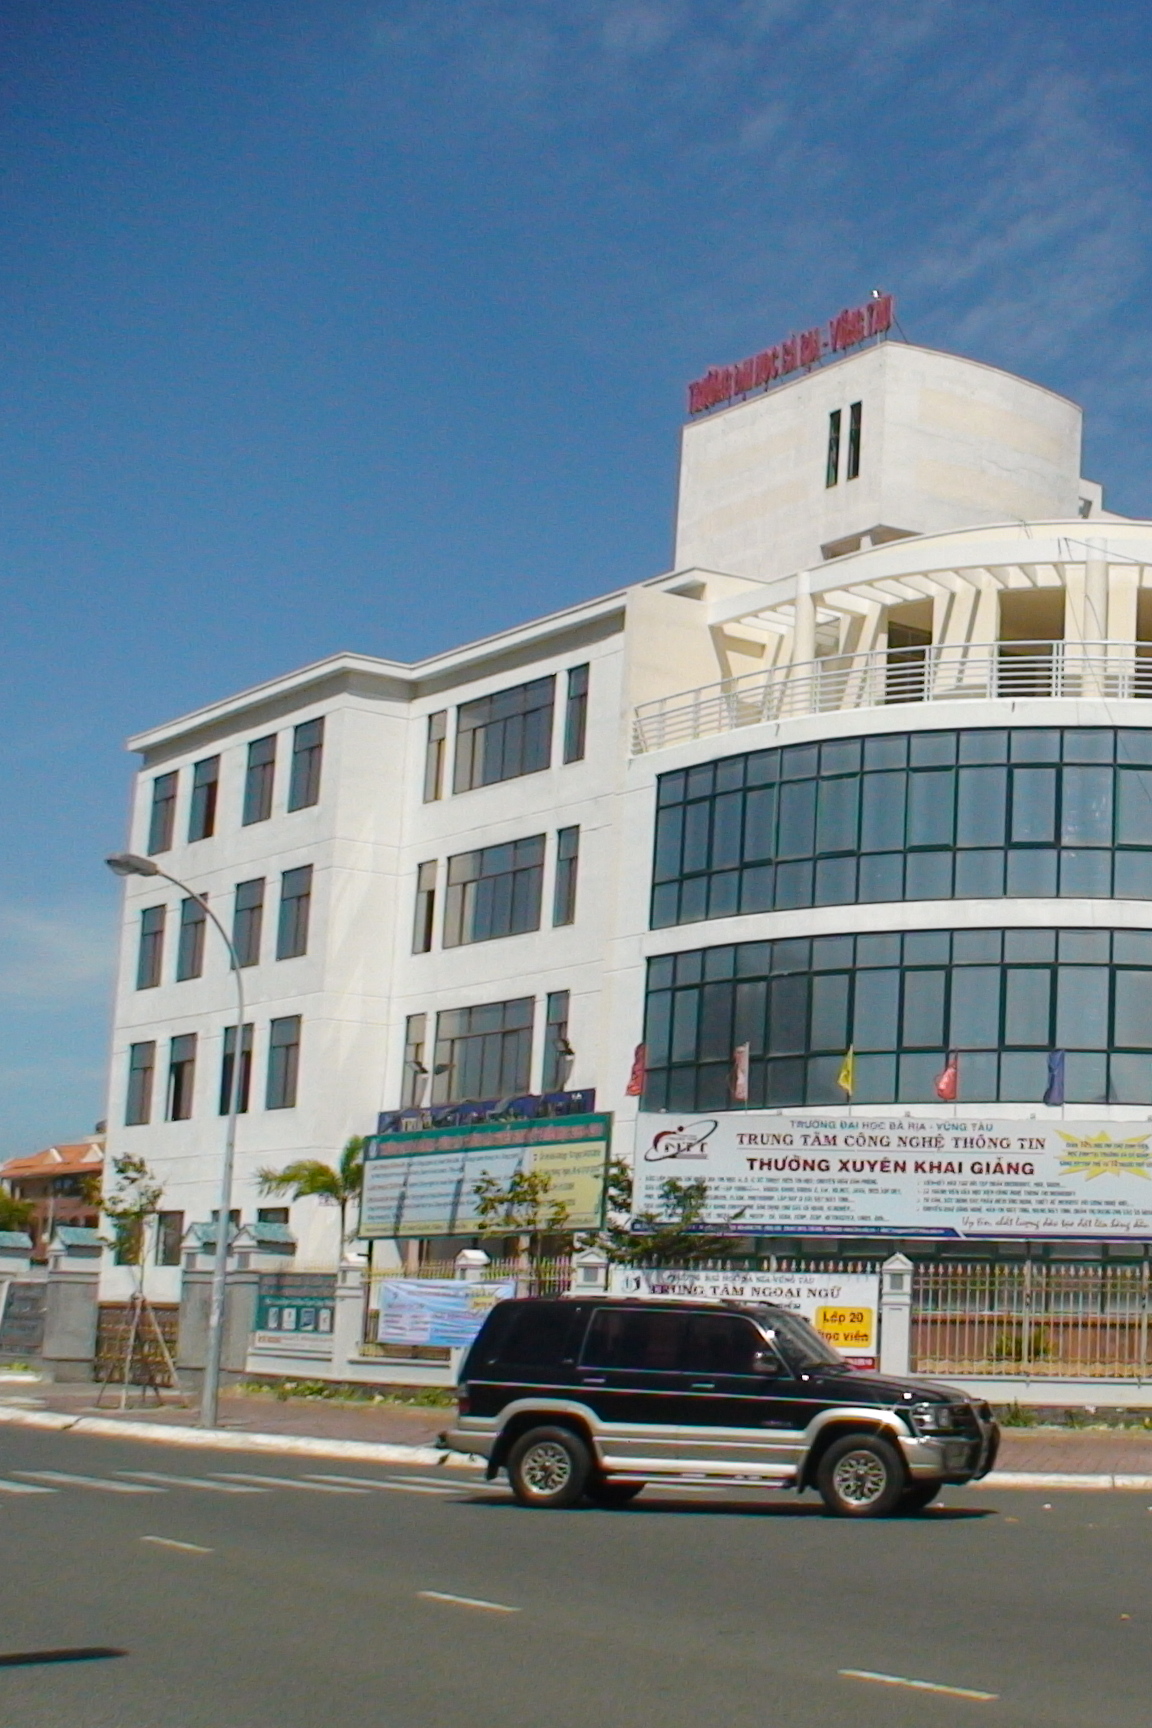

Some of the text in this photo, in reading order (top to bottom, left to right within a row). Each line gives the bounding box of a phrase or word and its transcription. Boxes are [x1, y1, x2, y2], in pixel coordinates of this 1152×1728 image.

[736, 1131, 1046, 1151] TRUNG TÂM CÔNG NGHỆ THÔNG TIN
[746, 1154, 1035, 1175] THƯỜNG XUYÊN KHAI GIẢNG
[650, 1284, 705, 1295] TRUNG
[710, 1284, 744, 1296] TÂM
[806, 1286, 842, 1298] NGỮ
[849, 1312, 864, 1323] 20
